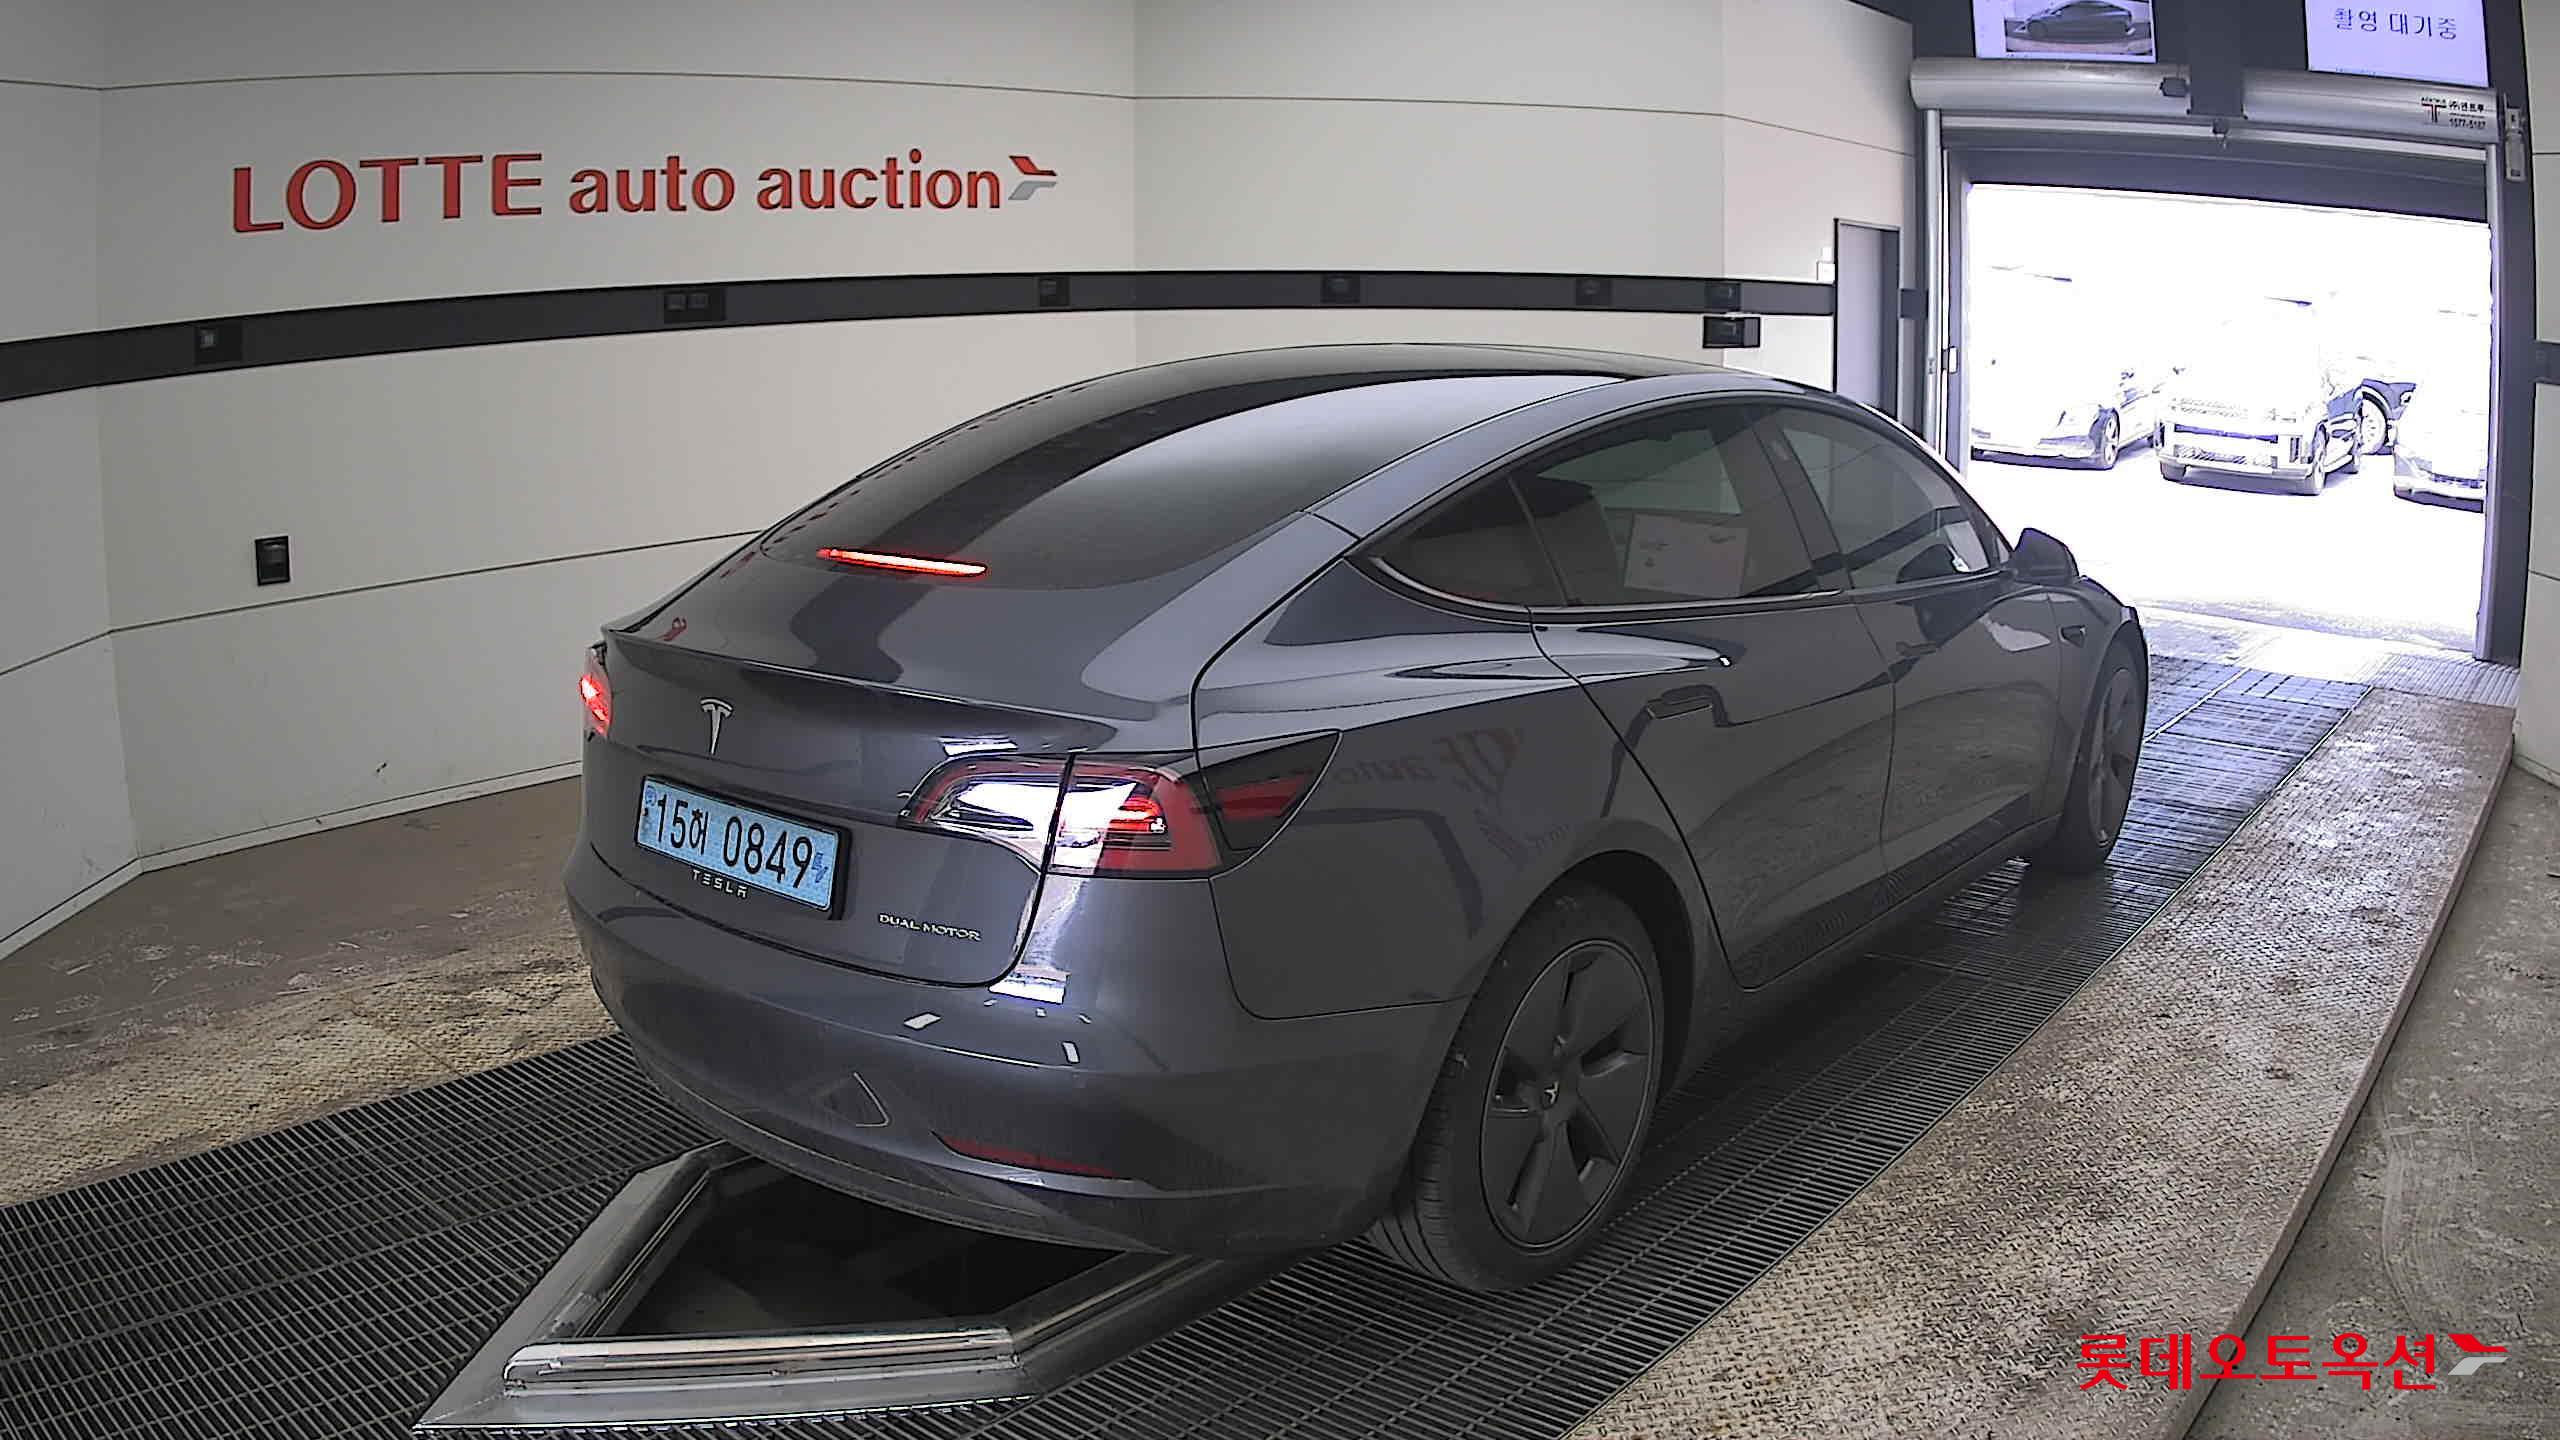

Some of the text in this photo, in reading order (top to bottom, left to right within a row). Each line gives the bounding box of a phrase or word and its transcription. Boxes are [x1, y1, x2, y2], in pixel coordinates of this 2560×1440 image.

[2335, 8, 2457, 40] 촬영 대기중
[232, 148, 1001, 233] LOTTE auto auction
[657, 794, 812, 888] 15허 0849
[692, 869, 748, 898] TESLA
[879, 914, 982, 941] DUAL MOTOR
